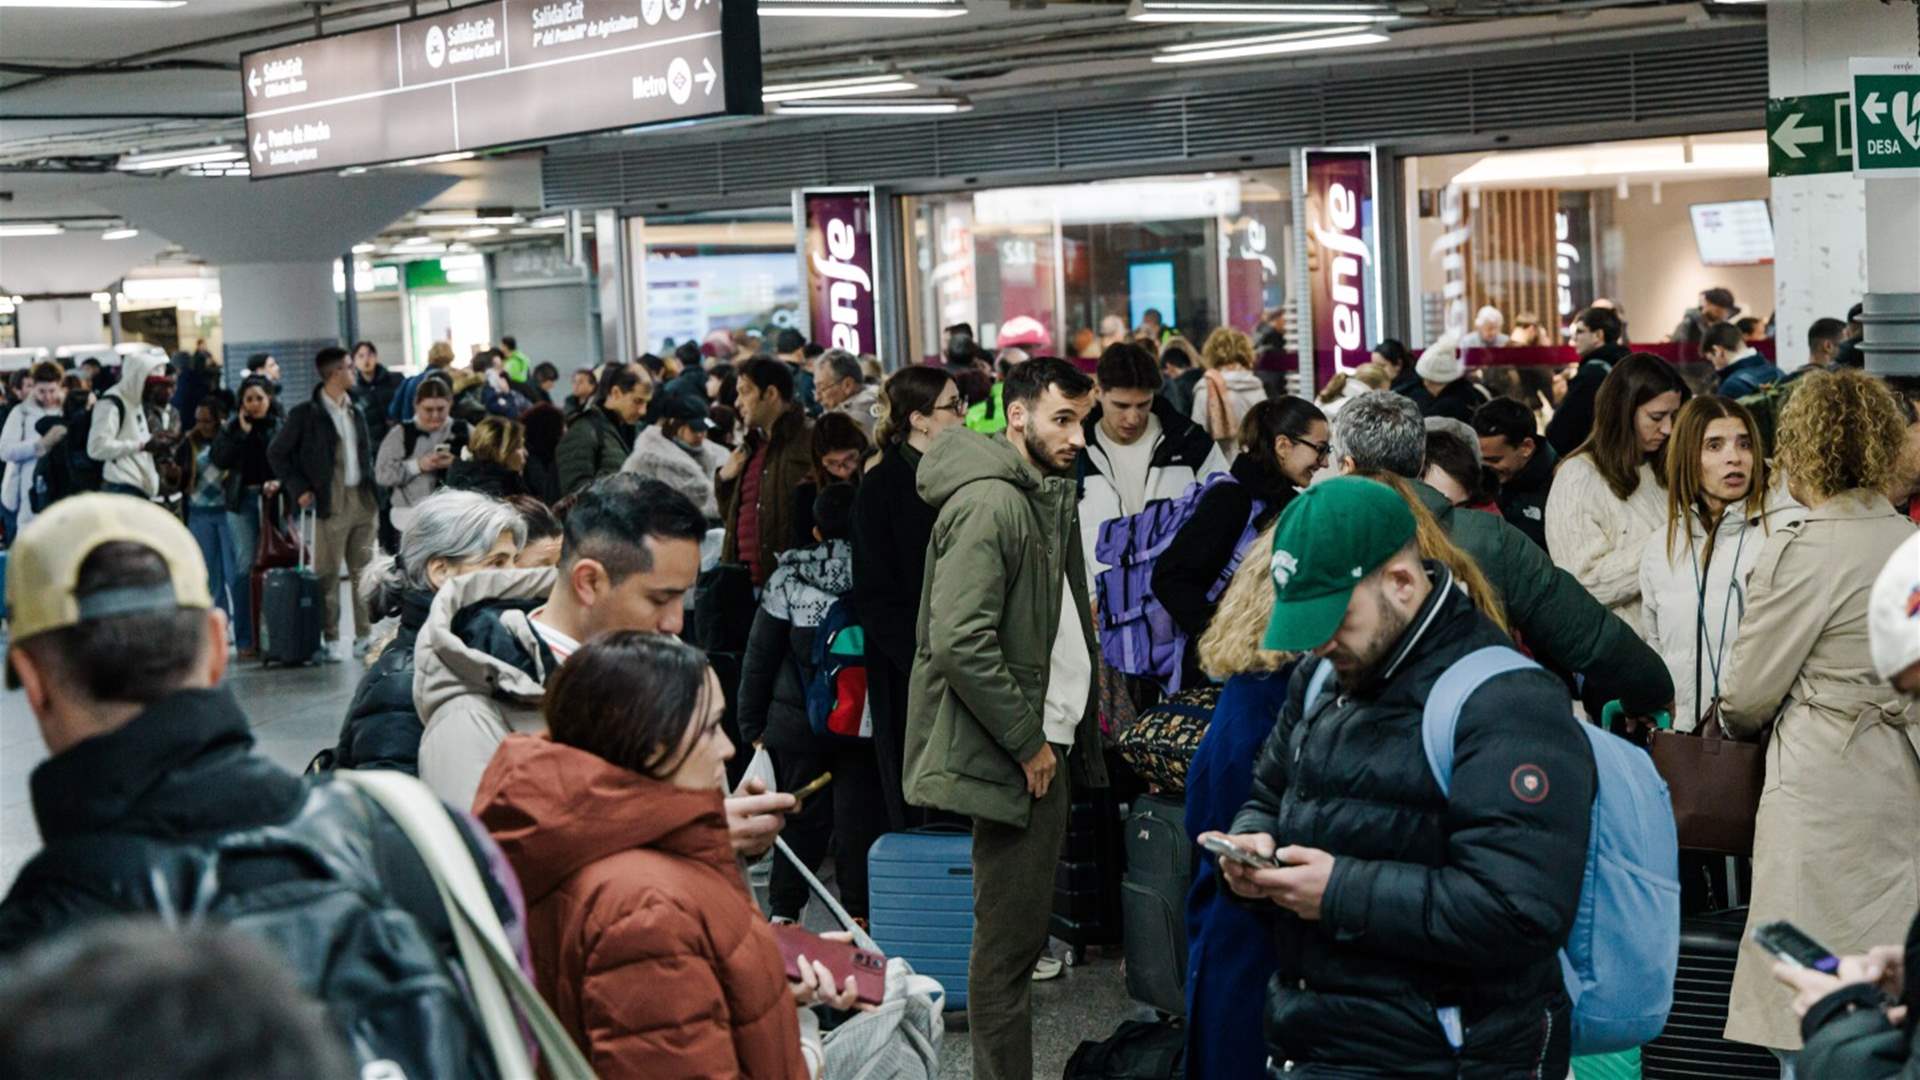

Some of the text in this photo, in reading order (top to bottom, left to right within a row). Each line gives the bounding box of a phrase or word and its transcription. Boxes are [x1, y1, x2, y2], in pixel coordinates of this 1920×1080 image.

[632, 75, 667, 100] Metro
[1867, 139, 1902, 155] DESA
[812, 217, 871, 358] enfe
